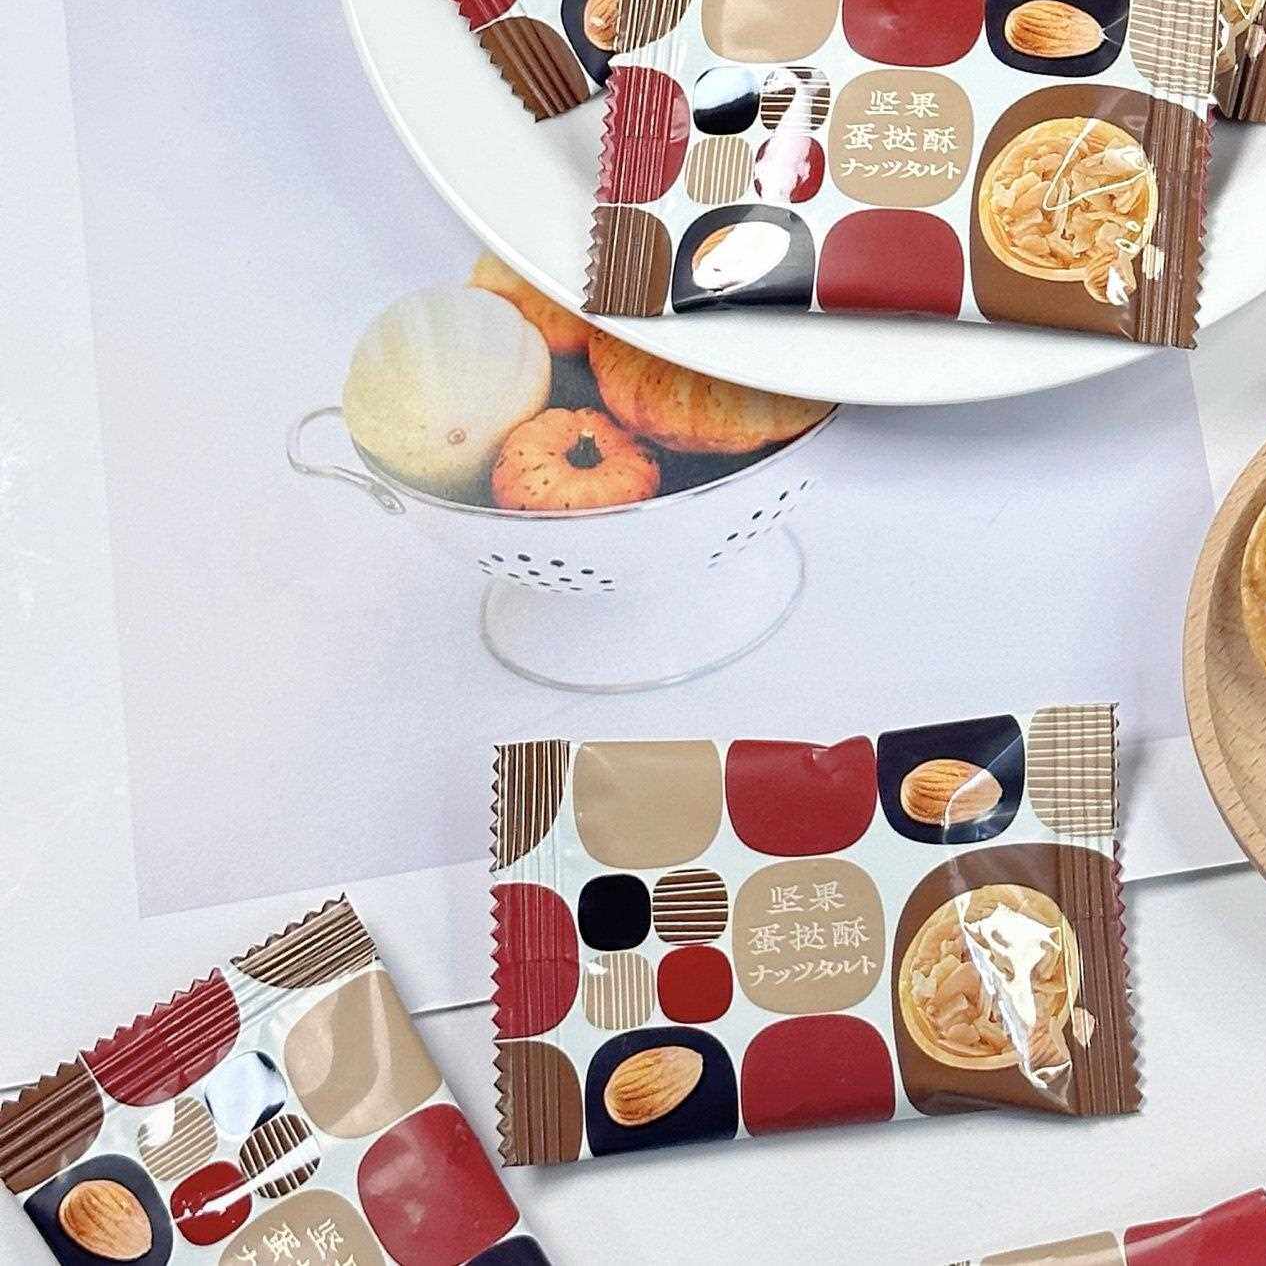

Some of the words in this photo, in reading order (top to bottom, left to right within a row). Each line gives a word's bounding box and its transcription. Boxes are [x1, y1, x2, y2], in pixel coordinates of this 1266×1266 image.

[864, 90, 940, 118] 坚果
[844, 122, 960, 154] 蛋挞酥
[839, 158, 961, 179] ナッツタルト
[767, 880, 846, 914] 坚果
[747, 916, 871, 956] 蛋挞酥
[748, 954, 878, 987] ナッツタルト
